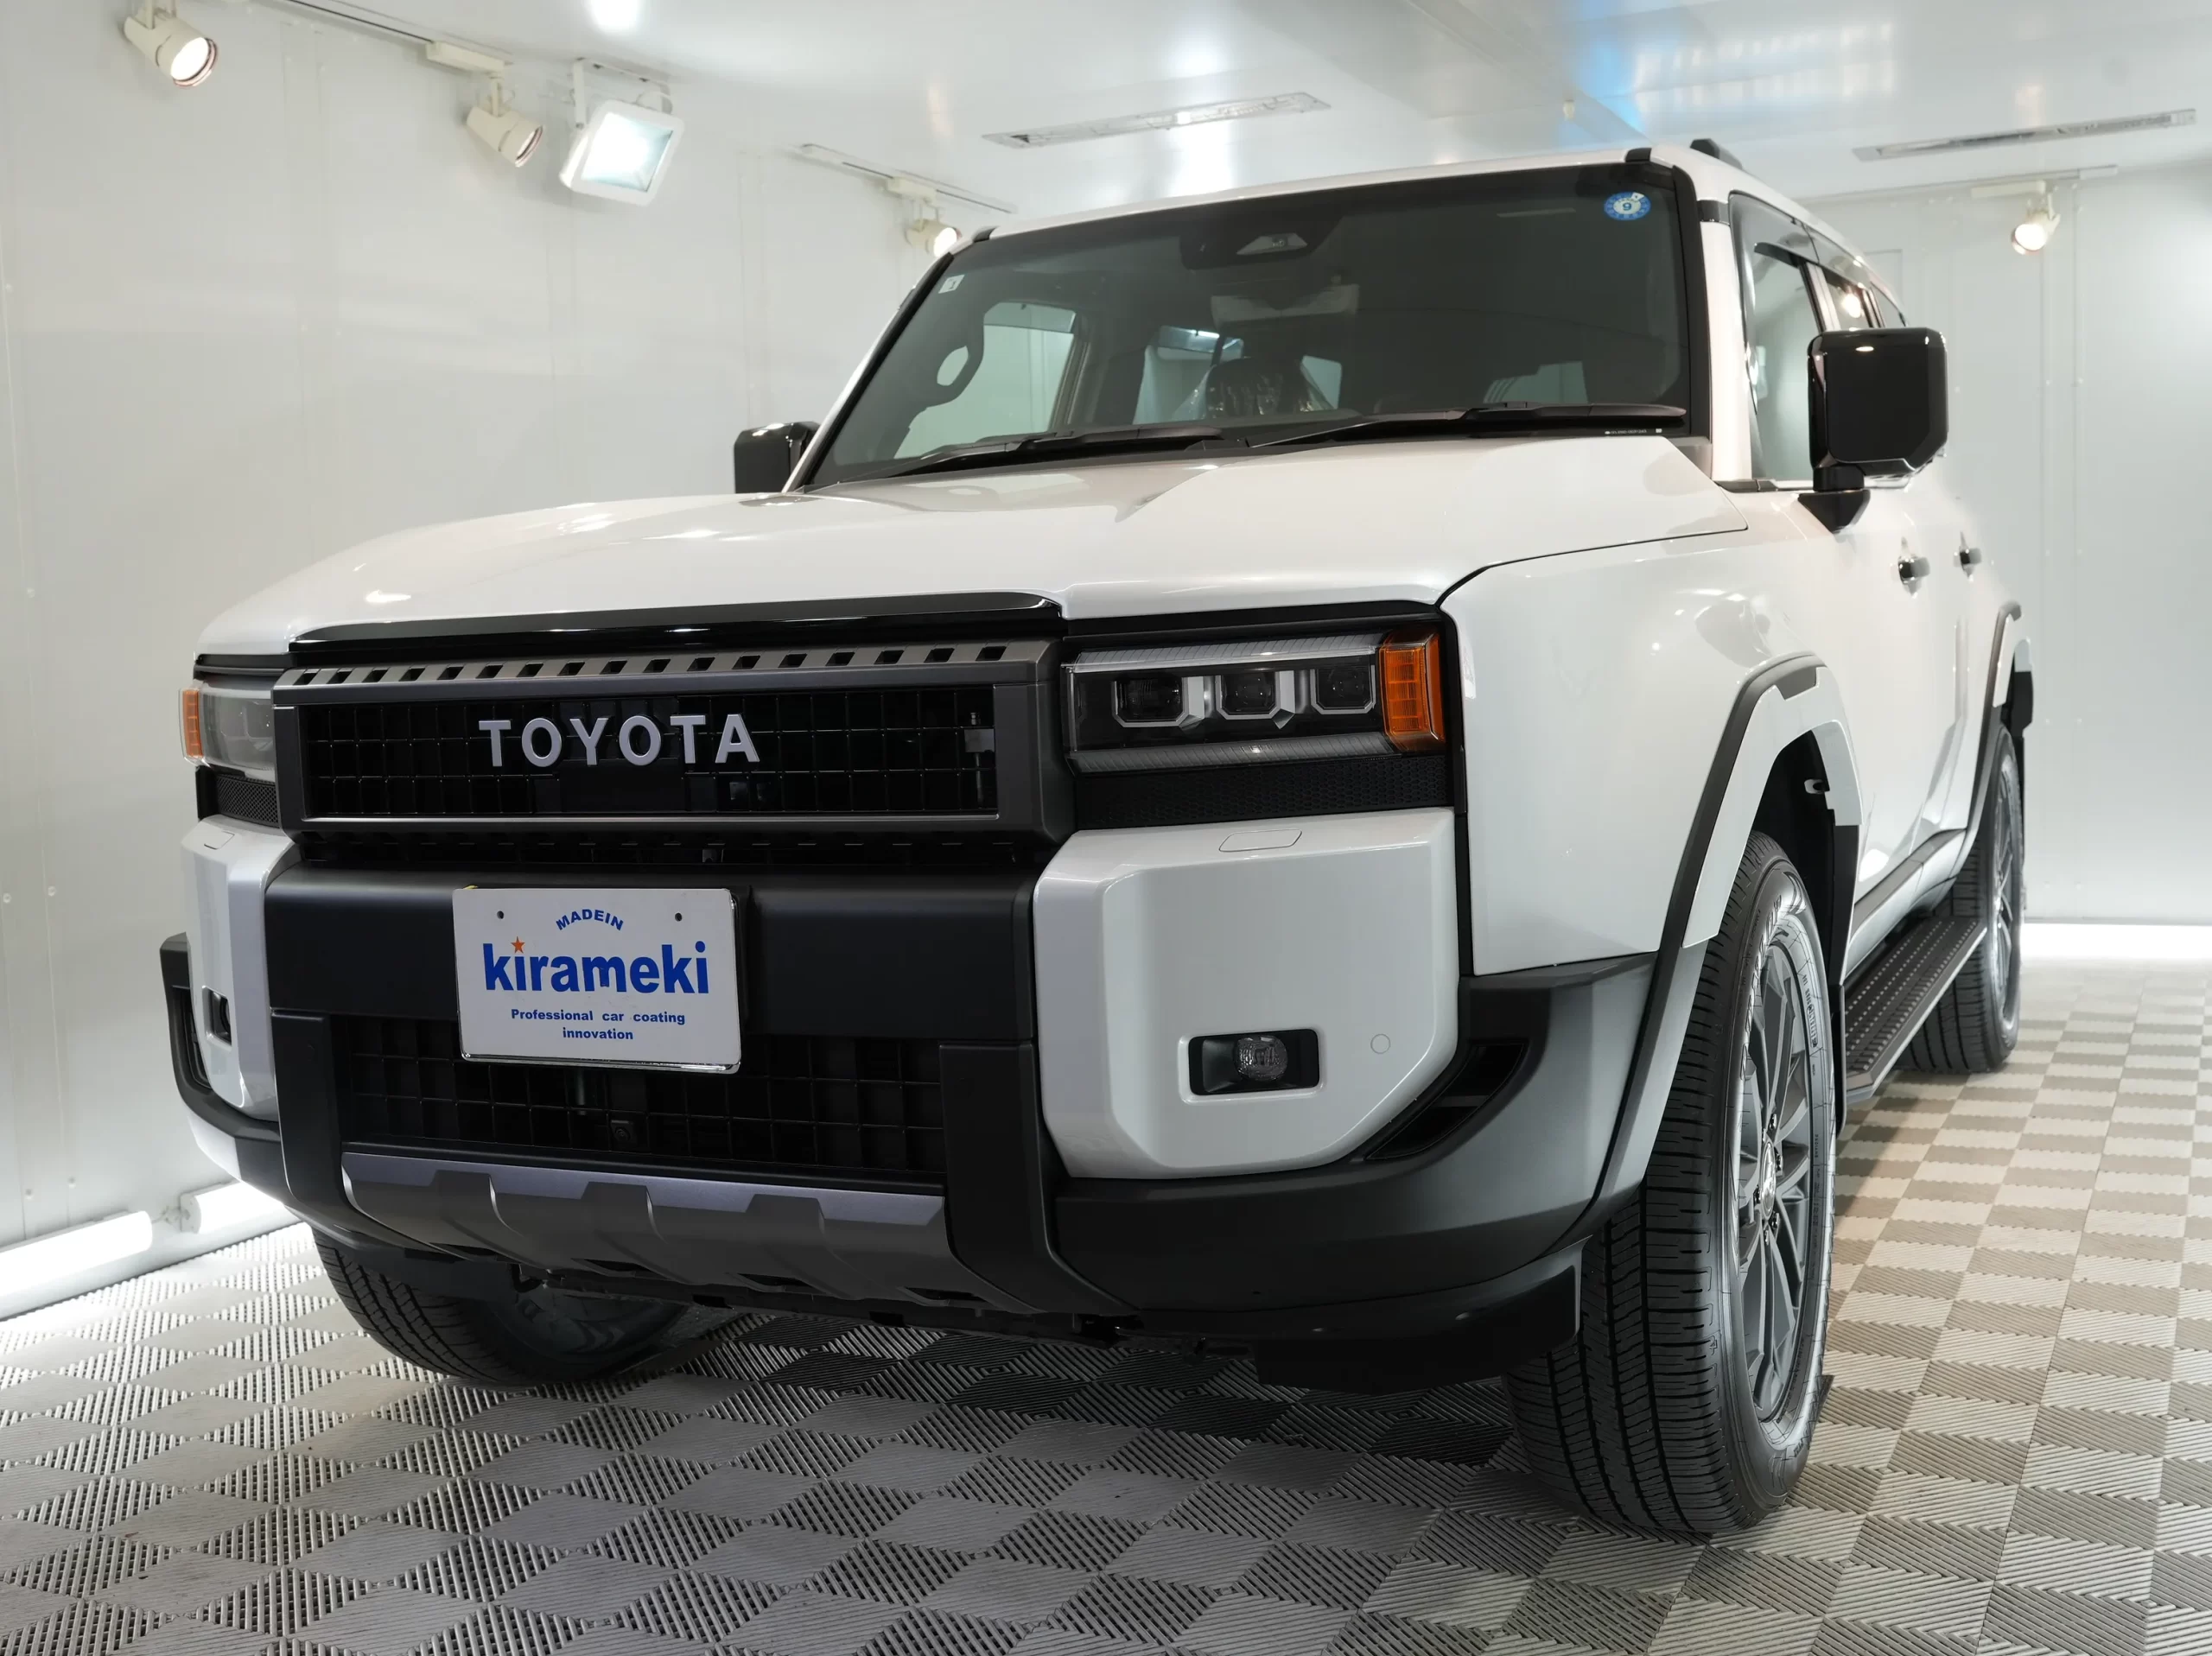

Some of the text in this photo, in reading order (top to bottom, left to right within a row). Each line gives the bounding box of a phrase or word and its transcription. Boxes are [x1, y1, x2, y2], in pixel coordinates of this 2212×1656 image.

[479, 714, 760, 767] TOYOTA
[556, 909, 623, 930] MADEIN
[483, 937, 709, 993] kirameki
[511, 1009, 685, 1025] Professional car coating
[563, 1027, 633, 1040] innovation
